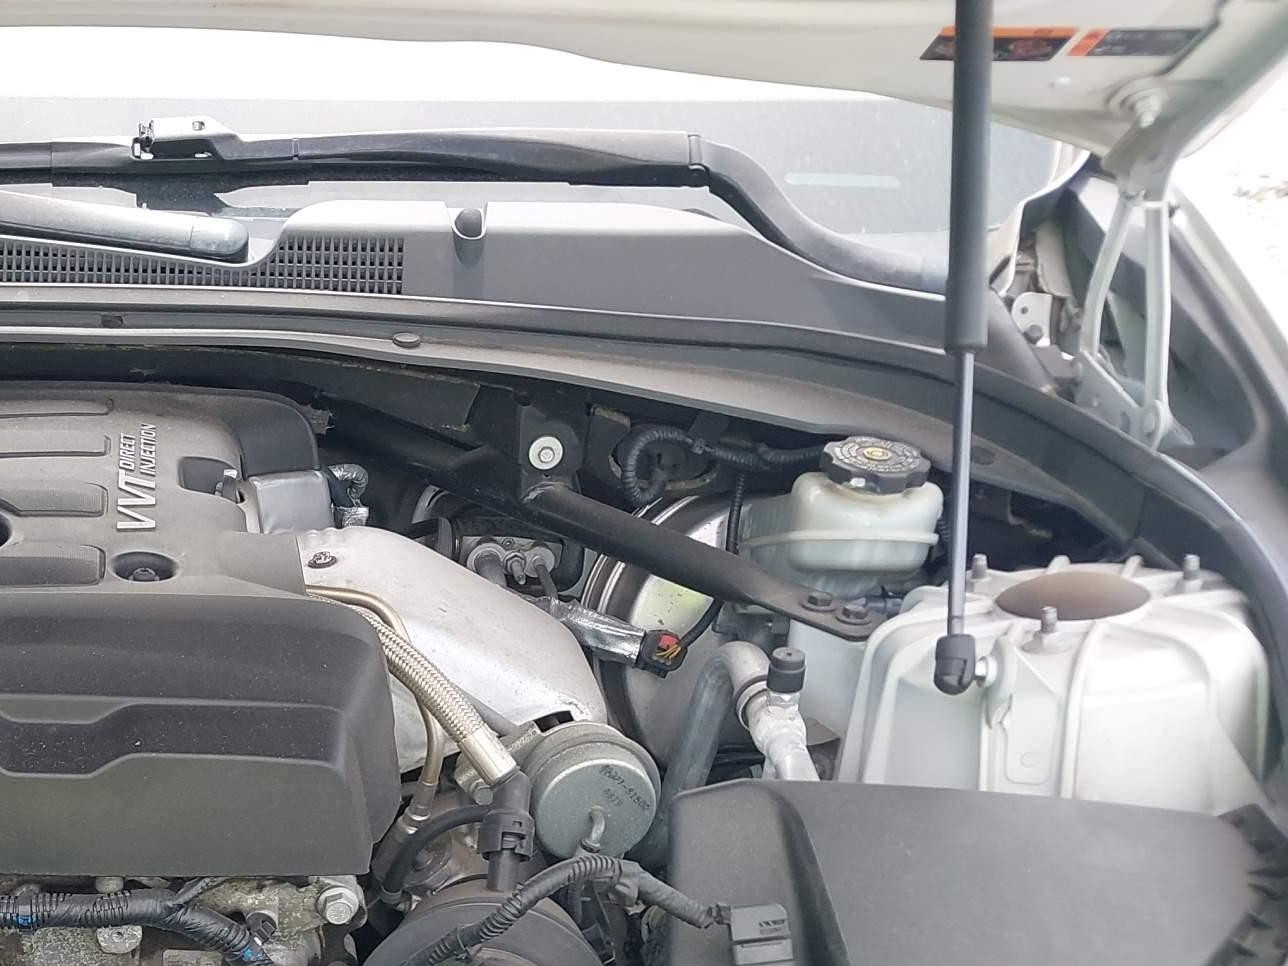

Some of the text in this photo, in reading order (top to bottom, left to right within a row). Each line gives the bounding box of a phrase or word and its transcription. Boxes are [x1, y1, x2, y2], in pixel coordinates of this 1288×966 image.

[118, 432, 136, 471] DIRECT
[139, 423, 157, 477] INJECTION
[116, 468, 156, 530] VVT
